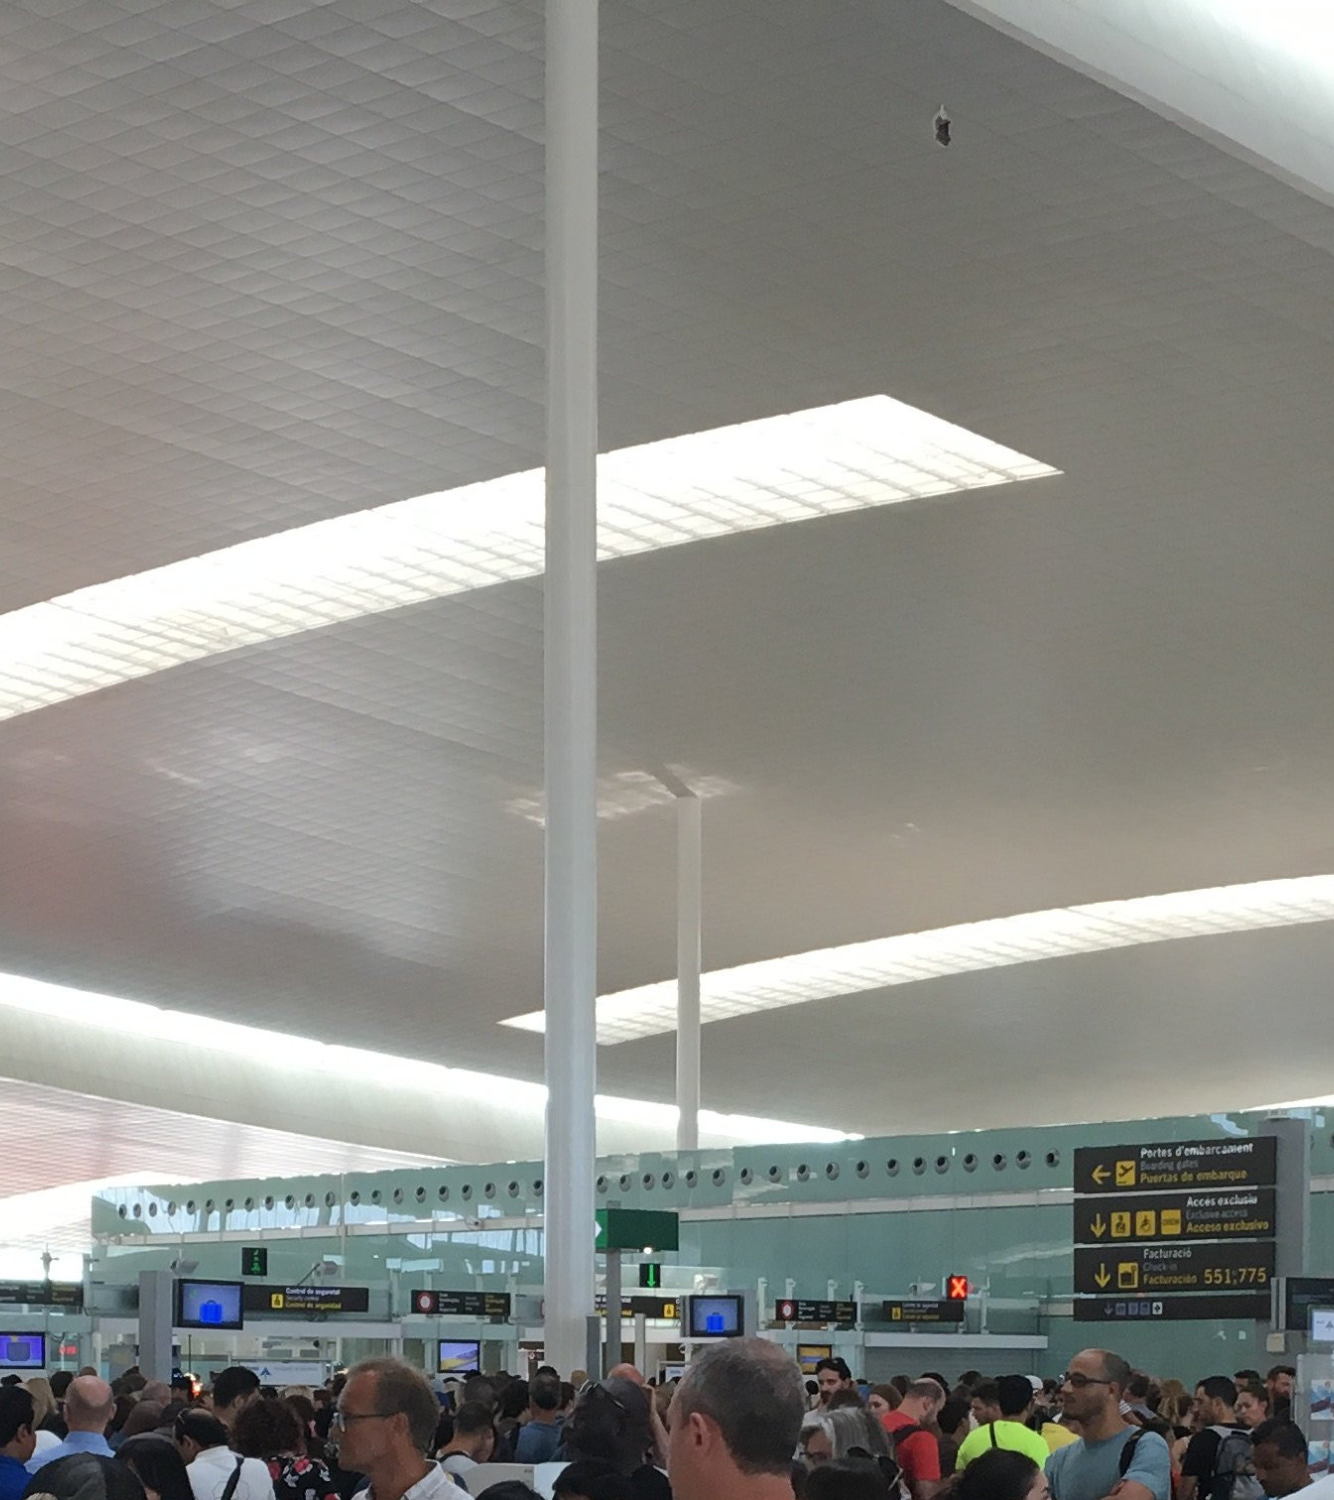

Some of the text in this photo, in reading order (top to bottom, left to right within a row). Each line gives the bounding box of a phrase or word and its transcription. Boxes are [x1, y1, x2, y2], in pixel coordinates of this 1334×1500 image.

[1140, 1146, 1172, 1159] Portes
[1140, 1169, 1248, 1184] Puertas de embarque
[1186, 1219, 1269, 1233] Acceso exclusivo
